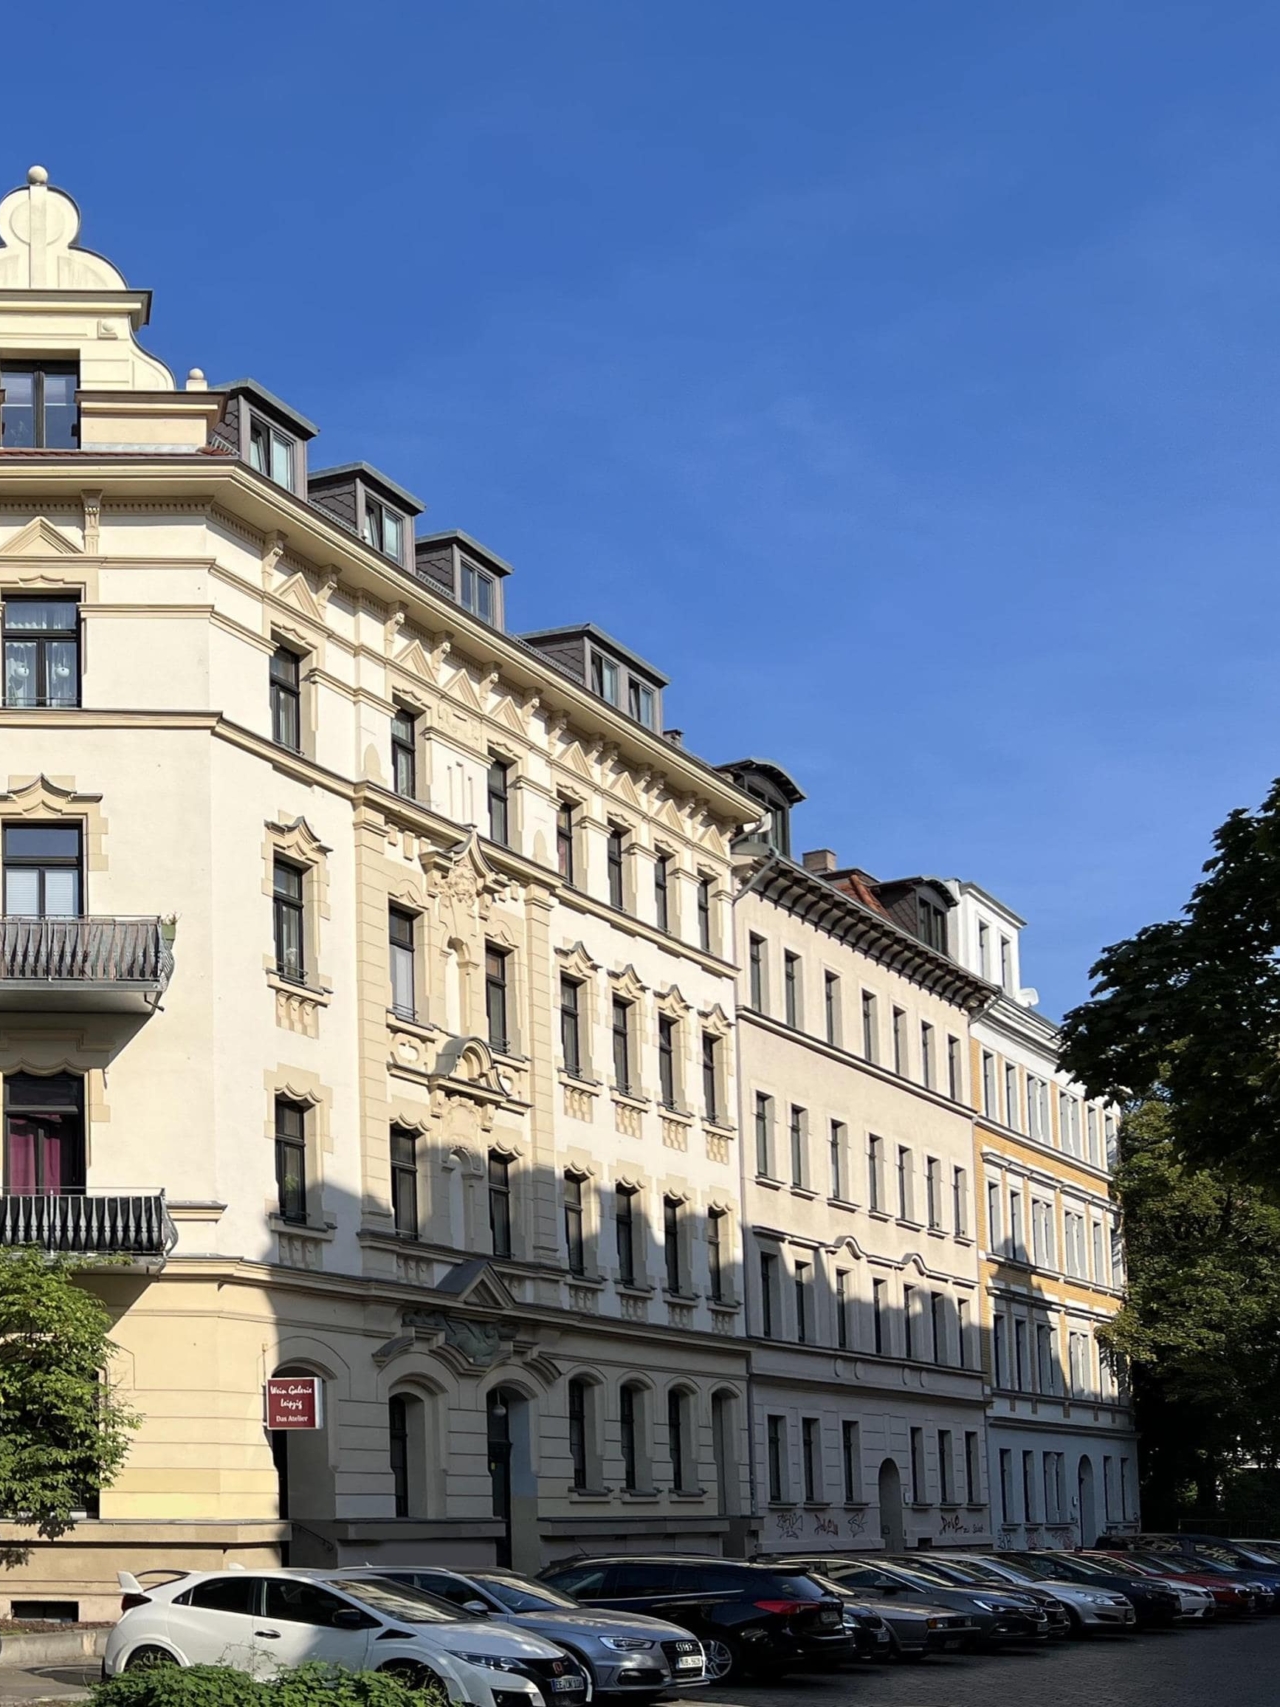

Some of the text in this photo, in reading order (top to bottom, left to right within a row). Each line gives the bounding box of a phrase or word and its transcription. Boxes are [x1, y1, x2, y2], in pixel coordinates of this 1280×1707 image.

[270, 1385, 312, 1395] Wein Galerie
[280, 1398, 302, 1410] Leipzig
